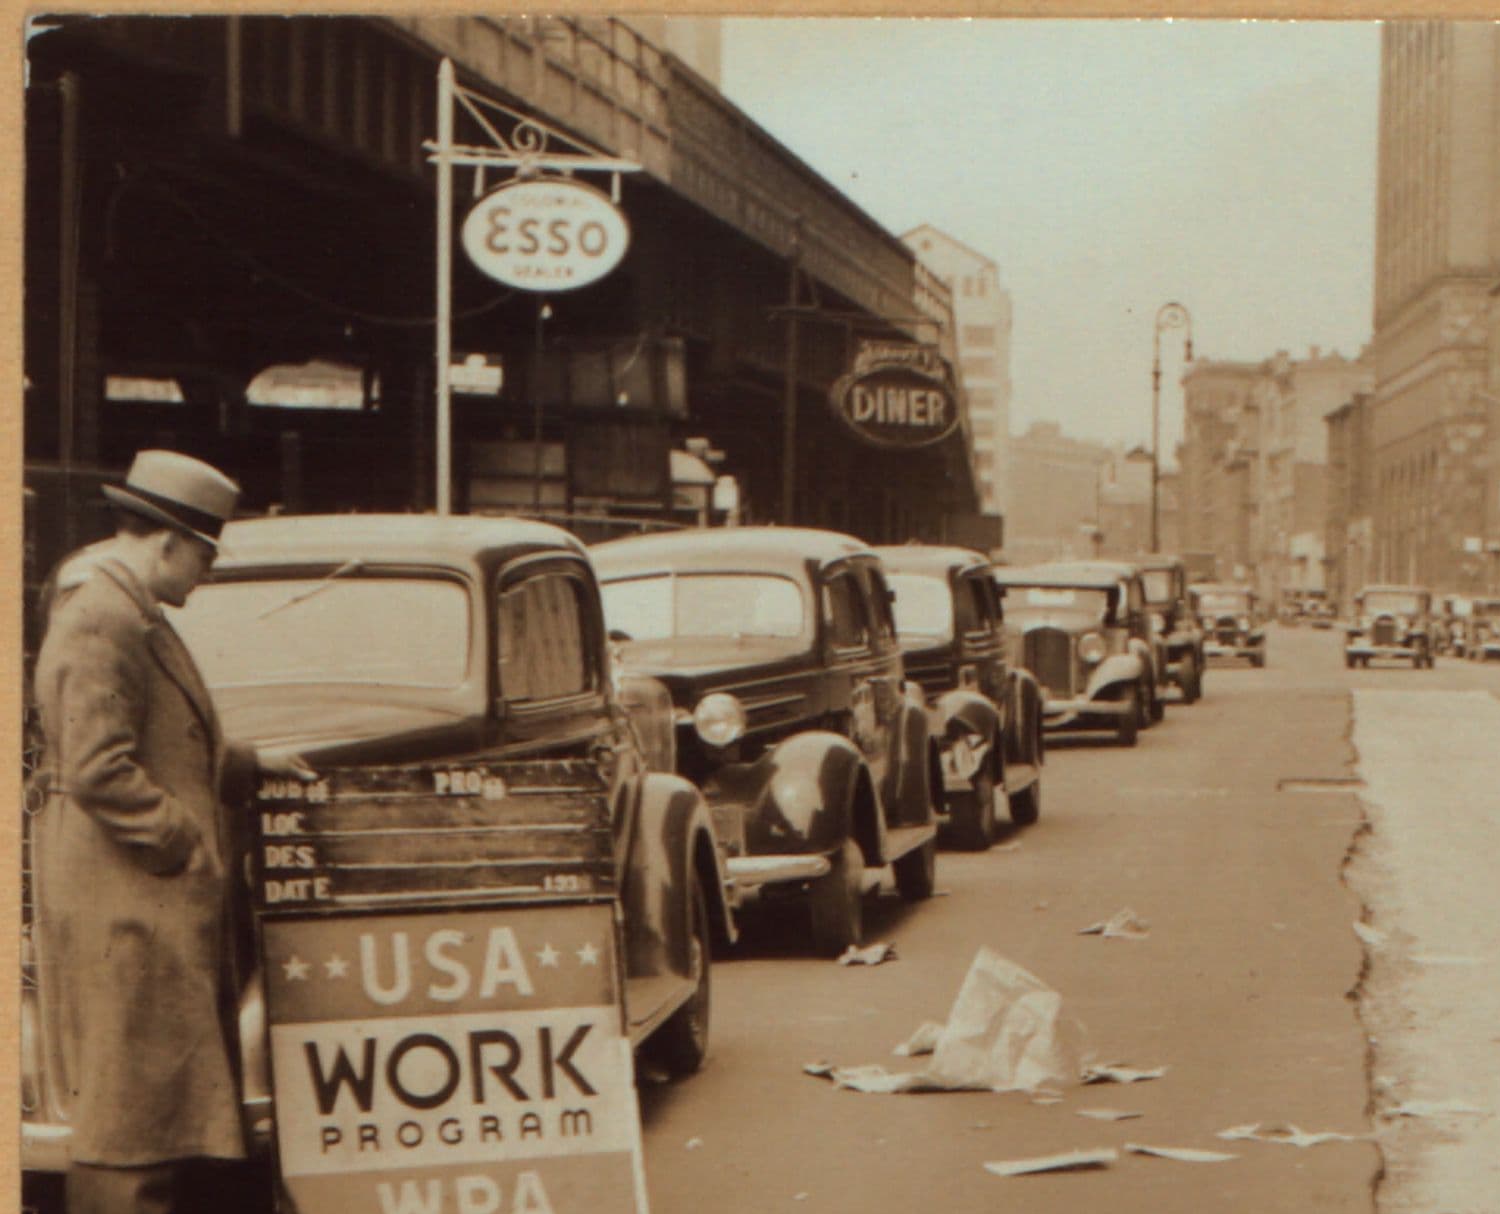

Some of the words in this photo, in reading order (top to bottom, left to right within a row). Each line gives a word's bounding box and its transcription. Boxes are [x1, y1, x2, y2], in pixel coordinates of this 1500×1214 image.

[852, 386, 944, 426] DINER
[265, 845, 316, 869] DES
[265, 876, 332, 903] DATE
[360, 927, 535, 1005] USA
[303, 1024, 598, 1116] WORK
[320, 1108, 594, 1154] PROGRAM
